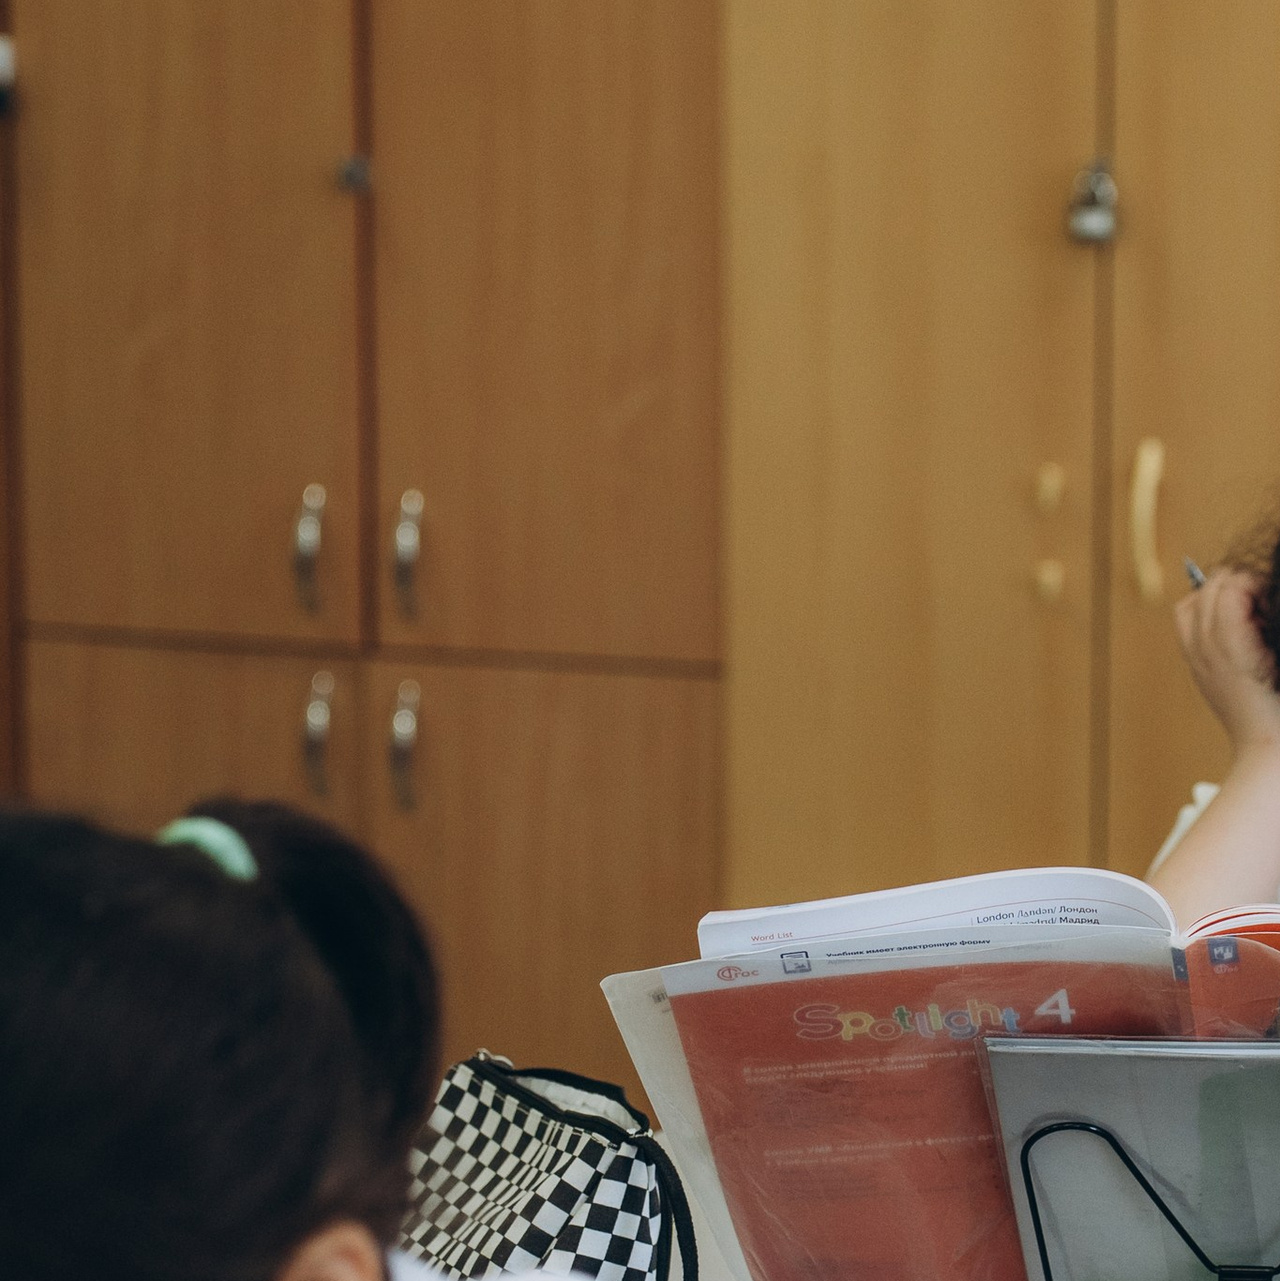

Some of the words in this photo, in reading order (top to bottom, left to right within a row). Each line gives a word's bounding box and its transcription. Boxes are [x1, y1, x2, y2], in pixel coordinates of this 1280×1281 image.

[976, 911, 1015, 924] London
[1059, 905, 1098, 914] Лондон
[1059, 916, 1101, 925] Мадрид
[751, 933, 775, 942] Word
[777, 931, 793, 939] List
[866, 946, 894, 954] имеет
[896, 941, 957, 952] электронную
[793, 998, 1021, 1041] Spotlight
[1034, 988, 1076, 1025] 4
